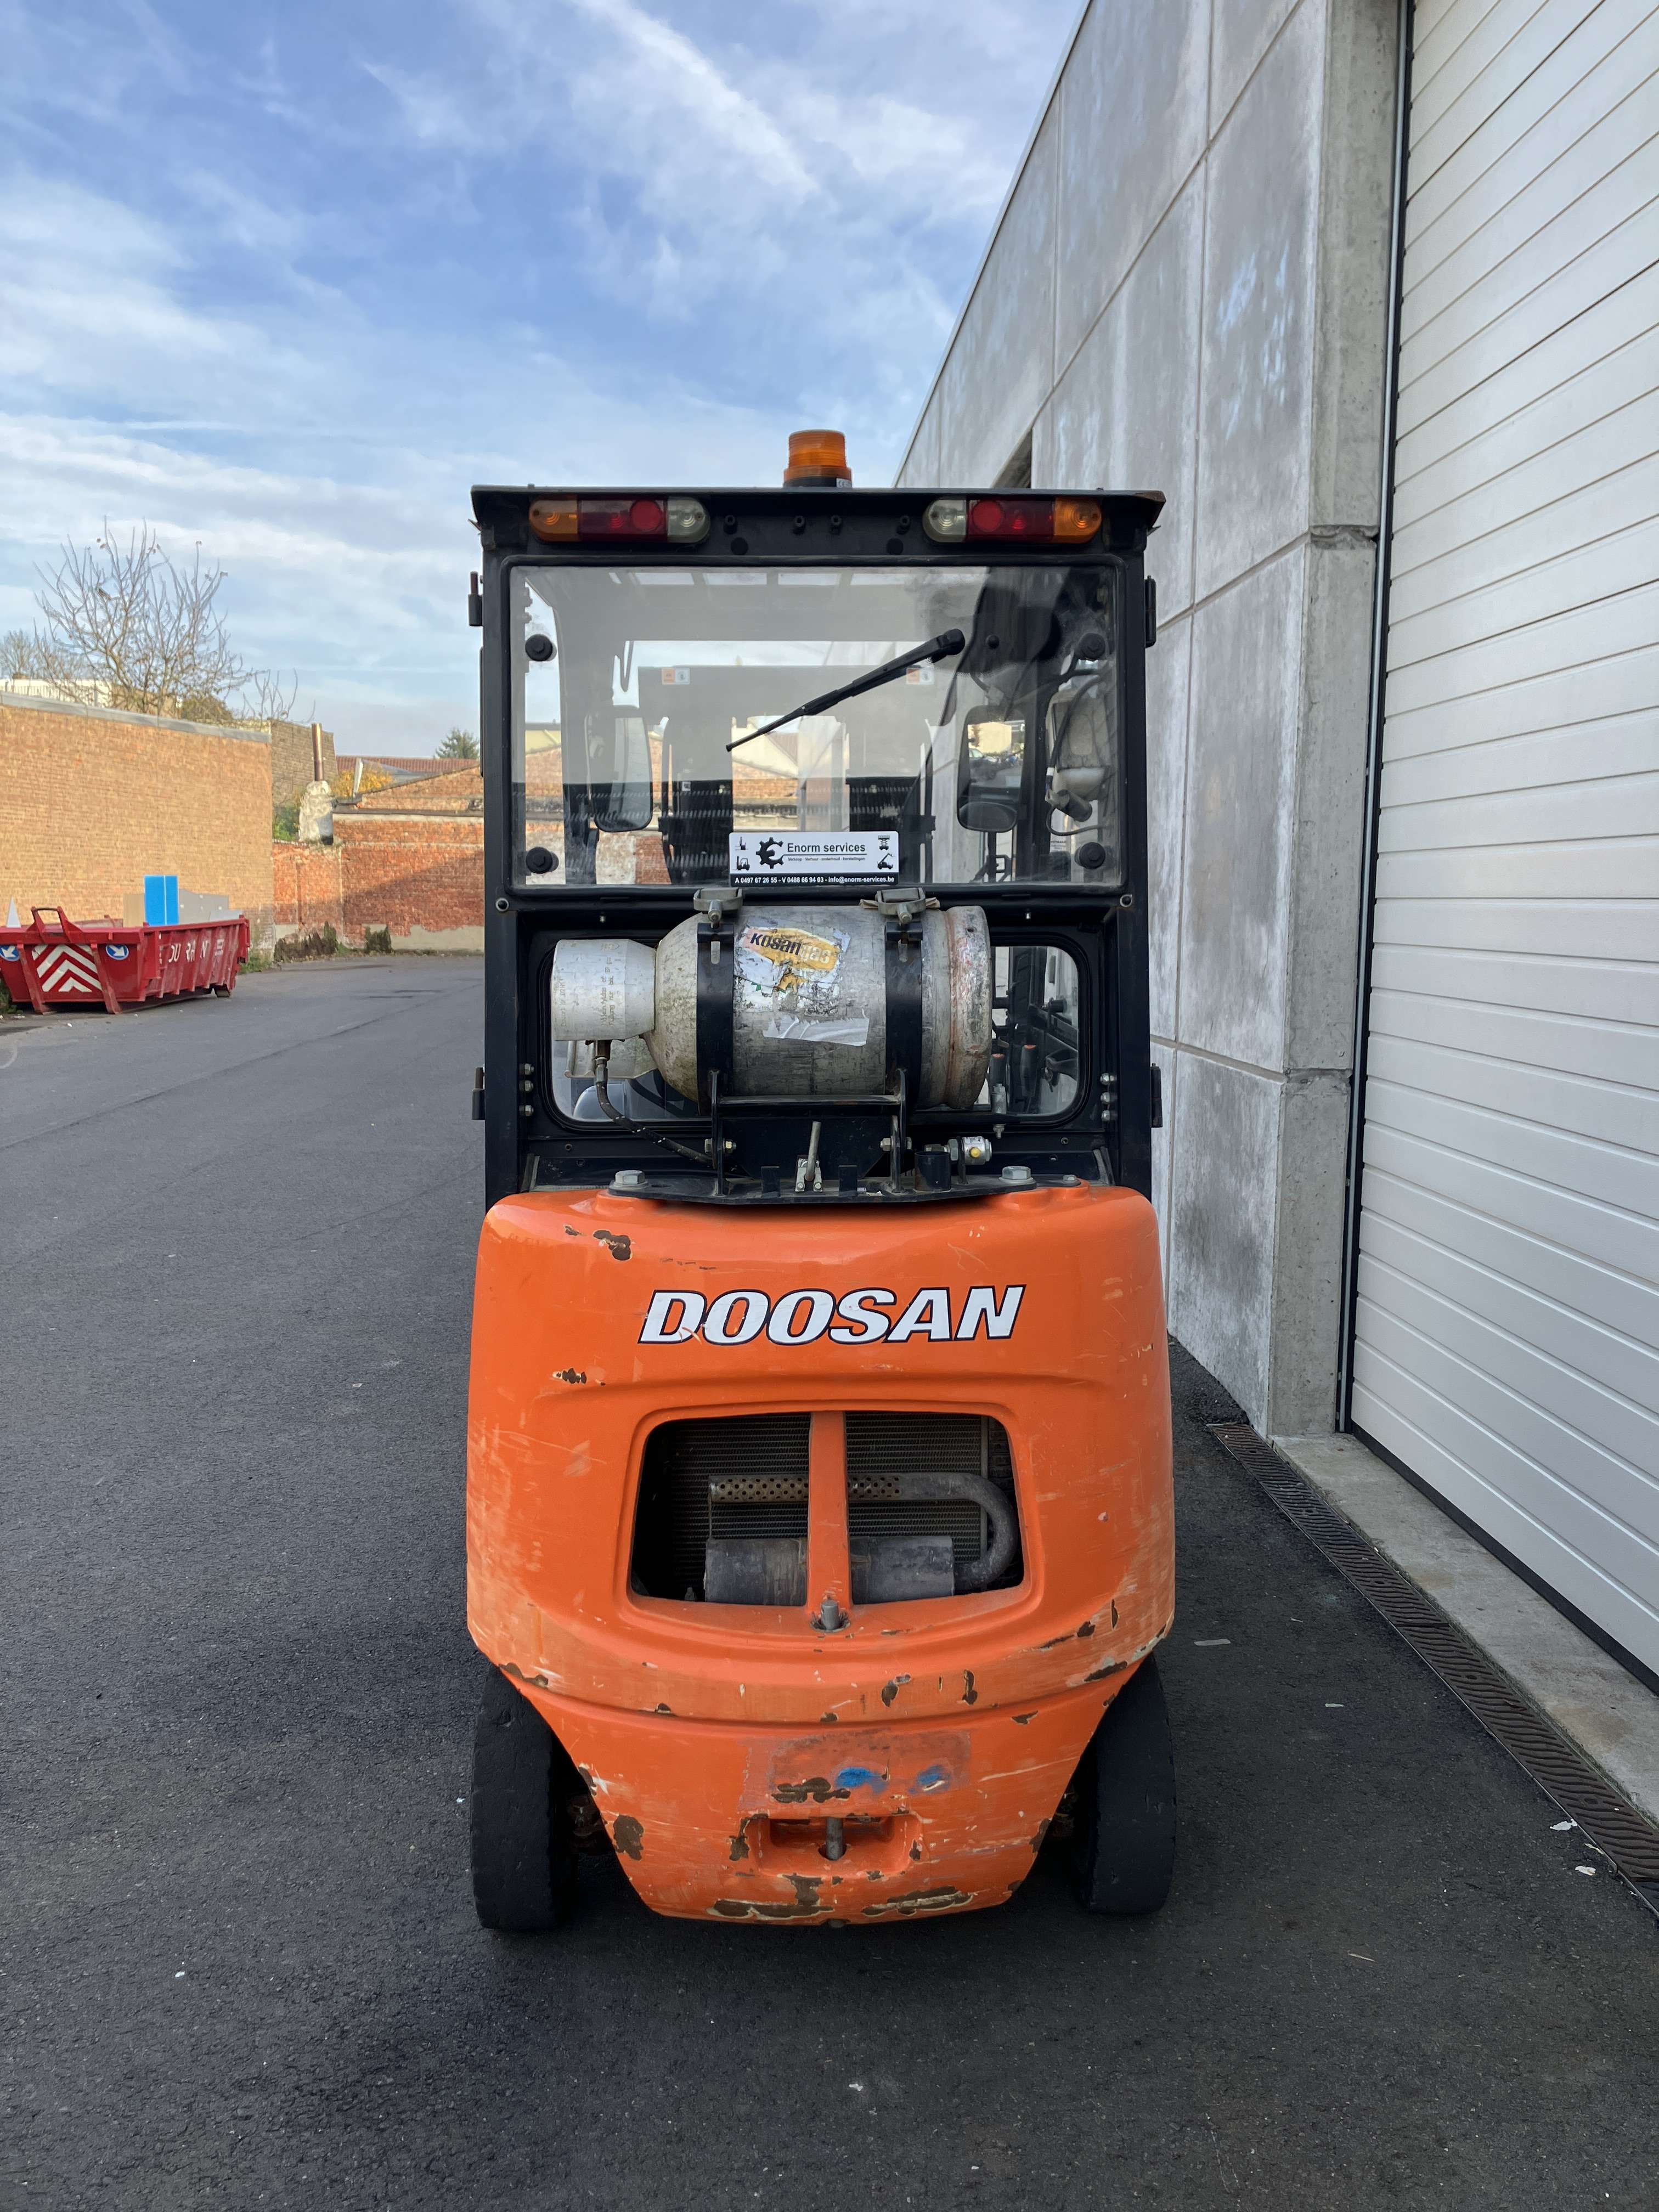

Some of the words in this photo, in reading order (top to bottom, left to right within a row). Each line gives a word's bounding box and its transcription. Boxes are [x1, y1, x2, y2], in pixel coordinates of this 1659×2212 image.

[787, 843, 820, 853] Enorm
[823, 842, 866, 852] services
[637, 1284, 1026, 1345] DOOSAN
